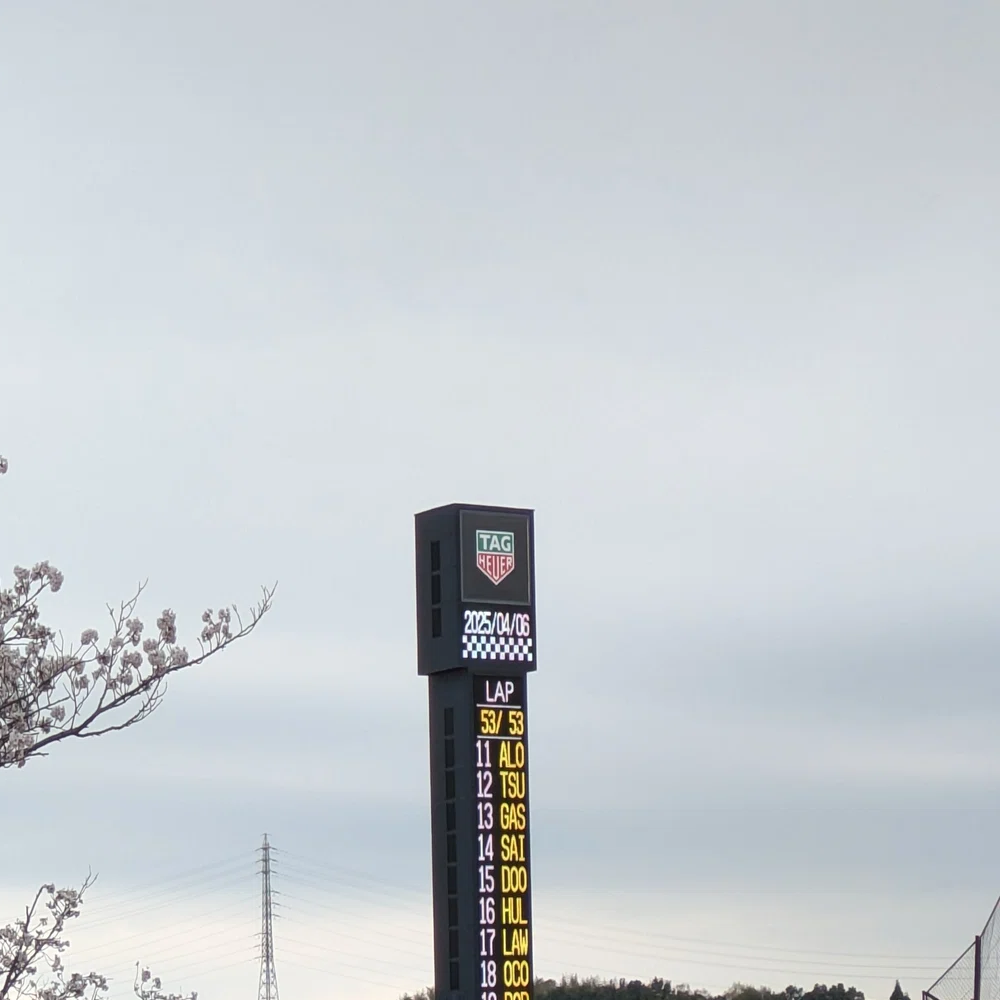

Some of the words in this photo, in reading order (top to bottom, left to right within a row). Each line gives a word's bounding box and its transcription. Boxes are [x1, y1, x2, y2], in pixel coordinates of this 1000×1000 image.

[479, 534, 511, 552] TAG
[479, 554, 512, 580] HEUER
[464, 610, 530, 636] 2025/04/06
[486, 680, 514, 703] LAP
[476, 740, 491, 767] 11
[499, 741, 525, 768] ALO
[476, 771, 493, 798] 12
[499, 771, 525, 799] TSU
[477, 802, 493, 829] 13
[500, 803, 526, 830] GAS
[478, 834, 494, 861] 14
[501, 834, 526, 862] SAI
[478, 865, 495, 893] 15
[501, 866, 527, 893] DOO
[479, 897, 495, 924] 16
[502, 897, 528, 925] HUL
[480, 928, 496, 956] 17
[503, 929, 529, 956] LAW
[481, 960, 497, 988] 18
[503, 960, 529, 987] OCO
